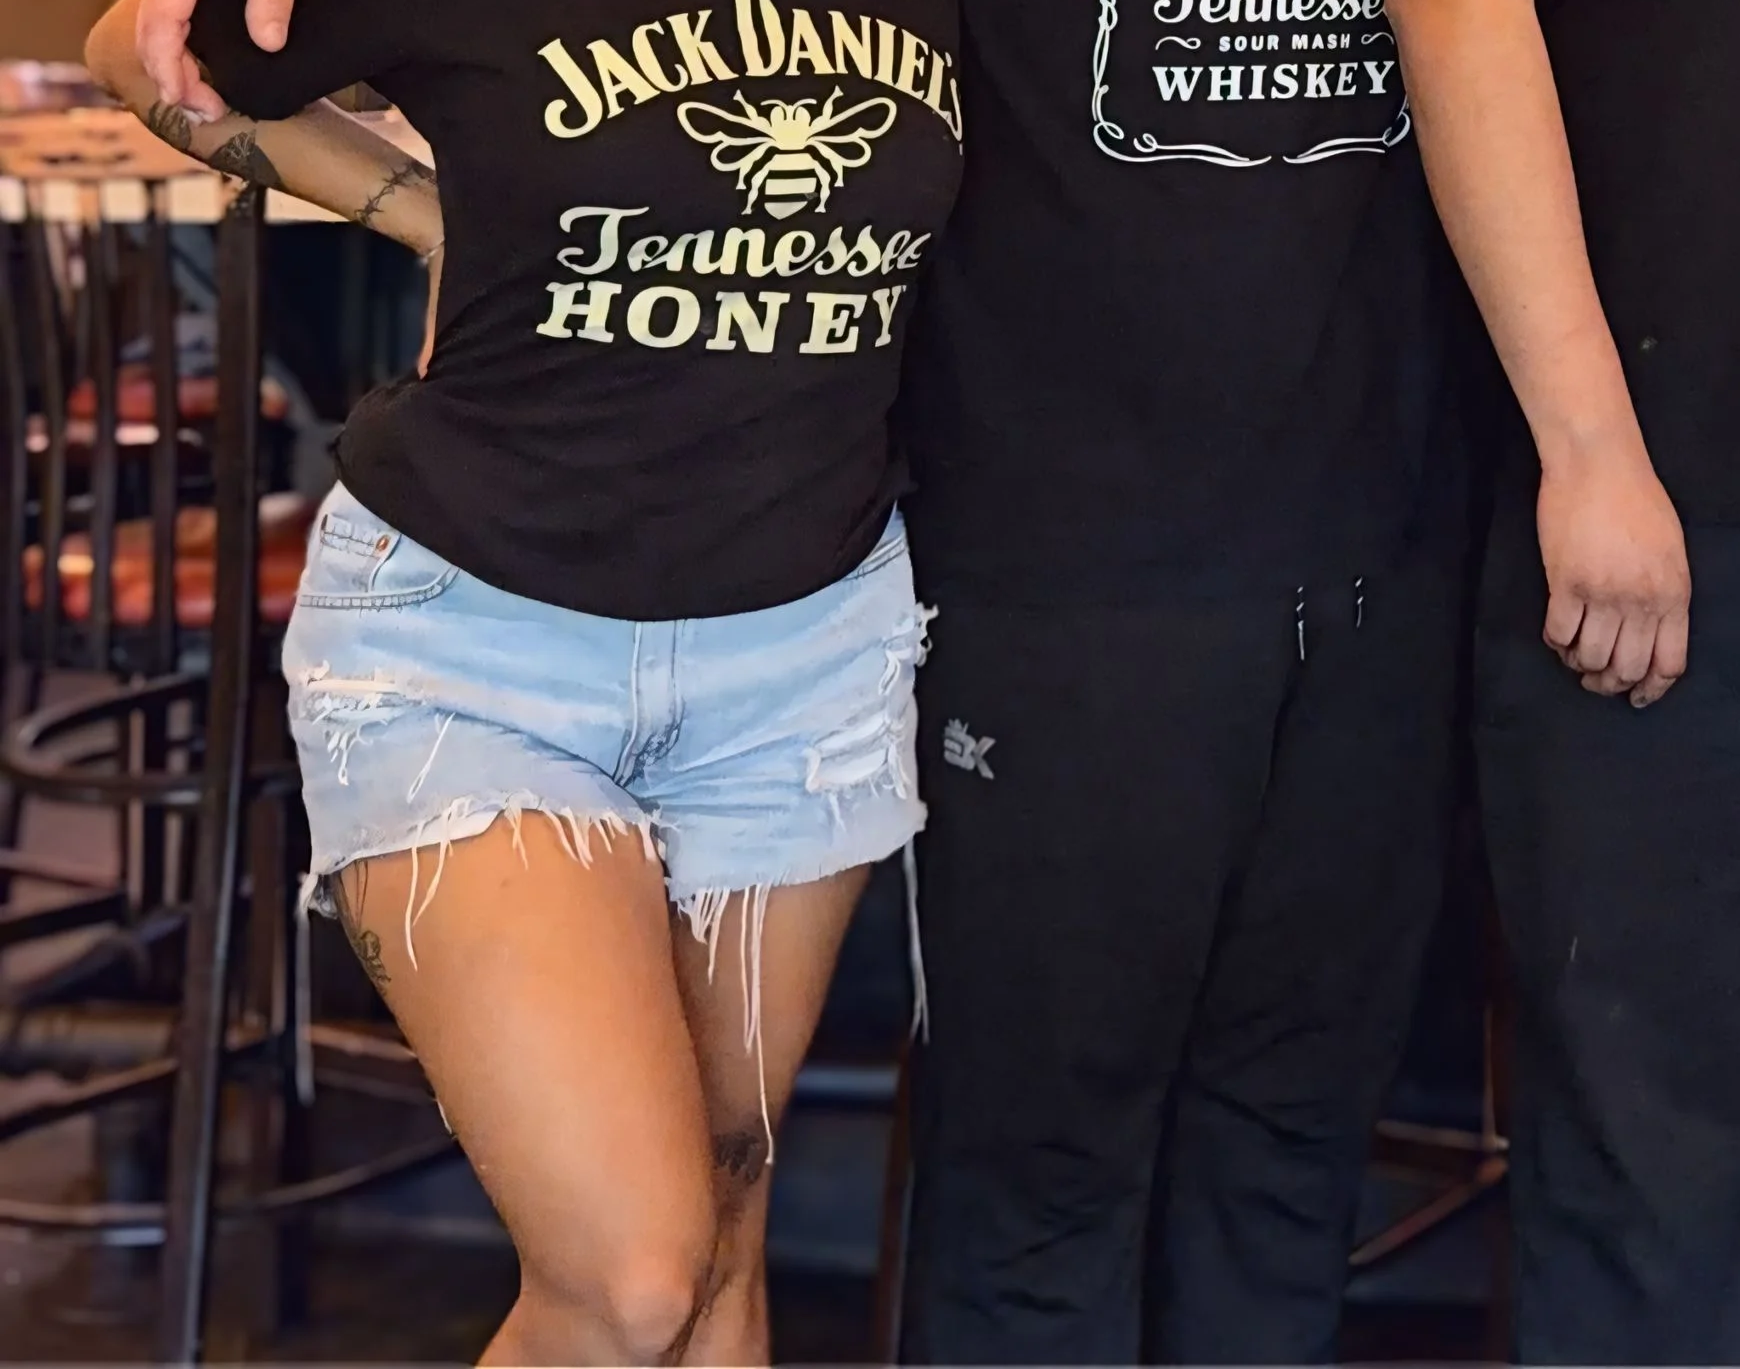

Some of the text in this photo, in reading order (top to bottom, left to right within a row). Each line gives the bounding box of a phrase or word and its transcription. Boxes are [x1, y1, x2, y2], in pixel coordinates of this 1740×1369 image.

[537, 9, 740, 139] JACK
[1218, 34, 1351, 52] SOUR MASH
[1151, 60, 1396, 102] WHISKEY
[556, 206, 932, 278] Tennessee
[535, 280, 908, 355] HONEY
